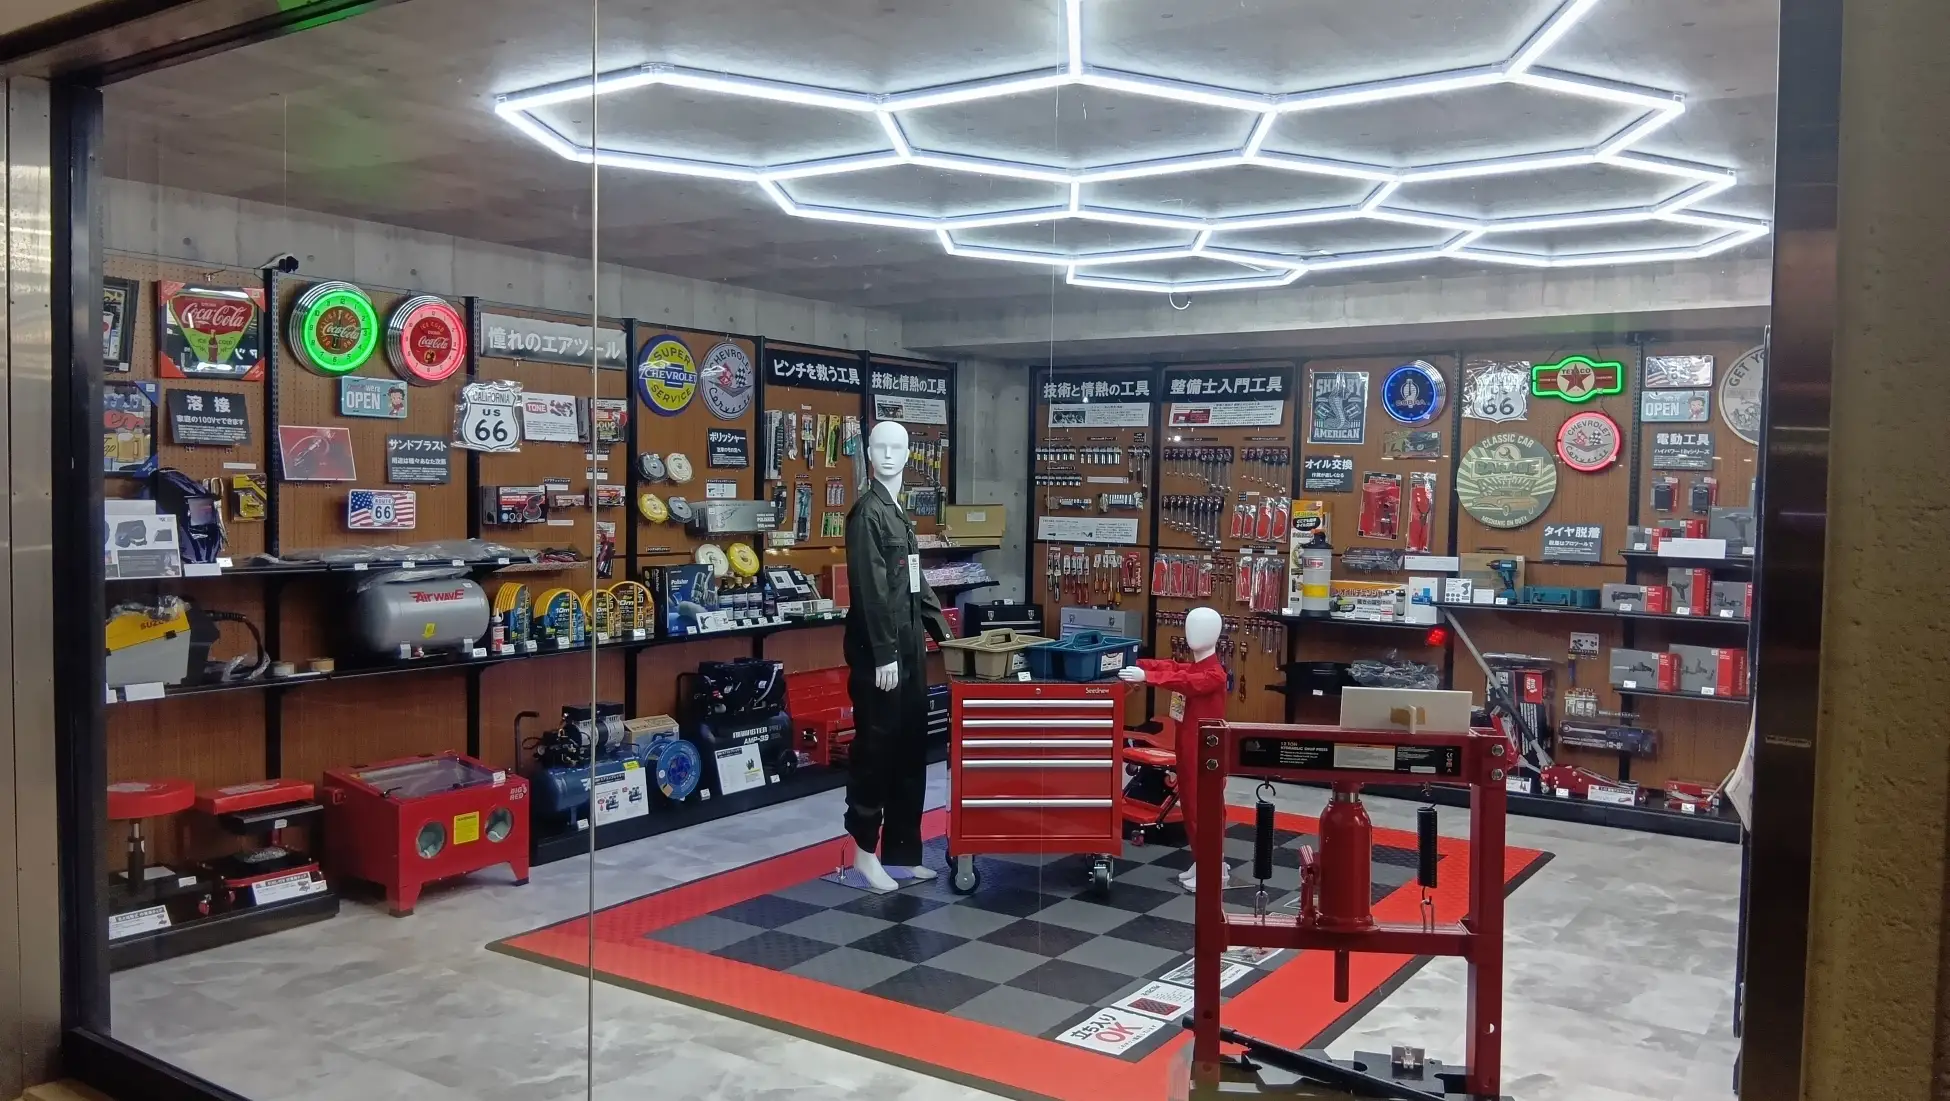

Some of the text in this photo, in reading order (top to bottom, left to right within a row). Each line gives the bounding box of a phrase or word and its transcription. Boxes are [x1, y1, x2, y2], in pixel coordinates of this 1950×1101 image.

[488, 326, 621, 359] 憧れのエアツール
[653, 348, 690, 365] SUPER
[645, 369, 697, 382] CHEVROLET
[774, 359, 860, 385] ピンチを救う工具
[1729, 362, 1750, 386] GET
[872, 371, 946, 395] 技術と情熱の工具
[1044, 380, 1149, 399] 技術と情熱の工具
[1170, 376, 1282, 395] 整備士入門工具
[346, 391, 380, 409] OPEN
[472, 390, 510, 403] CALIFORNIA
[651, 384, 691, 403] SERVICE
[527, 402, 547, 412] TONE
[1483, 397, 1514, 415] 66
[1645, 402, 1679, 416] OPEN
[475, 419, 508, 442] 66
[1313, 428, 1360, 438] AMERICAN
[1568, 420, 1611, 437] CHEVROLET
[709, 432, 746, 443] ポリッシャー
[1482, 434, 1534, 448] CLASSIC CAR
[1657, 433, 1710, 445] 電動工具
[1305, 459, 1352, 470] オイル交換
[375, 506, 391, 519] 66
[1481, 516, 1505, 526] MECHANIC
[1515, 516, 1527, 525] DUTY
[1544, 526, 1600, 538] タイヤ脱着
[1070, 1014, 1116, 1040] 立ち入り
[1096, 1022, 1142, 1042] OK
